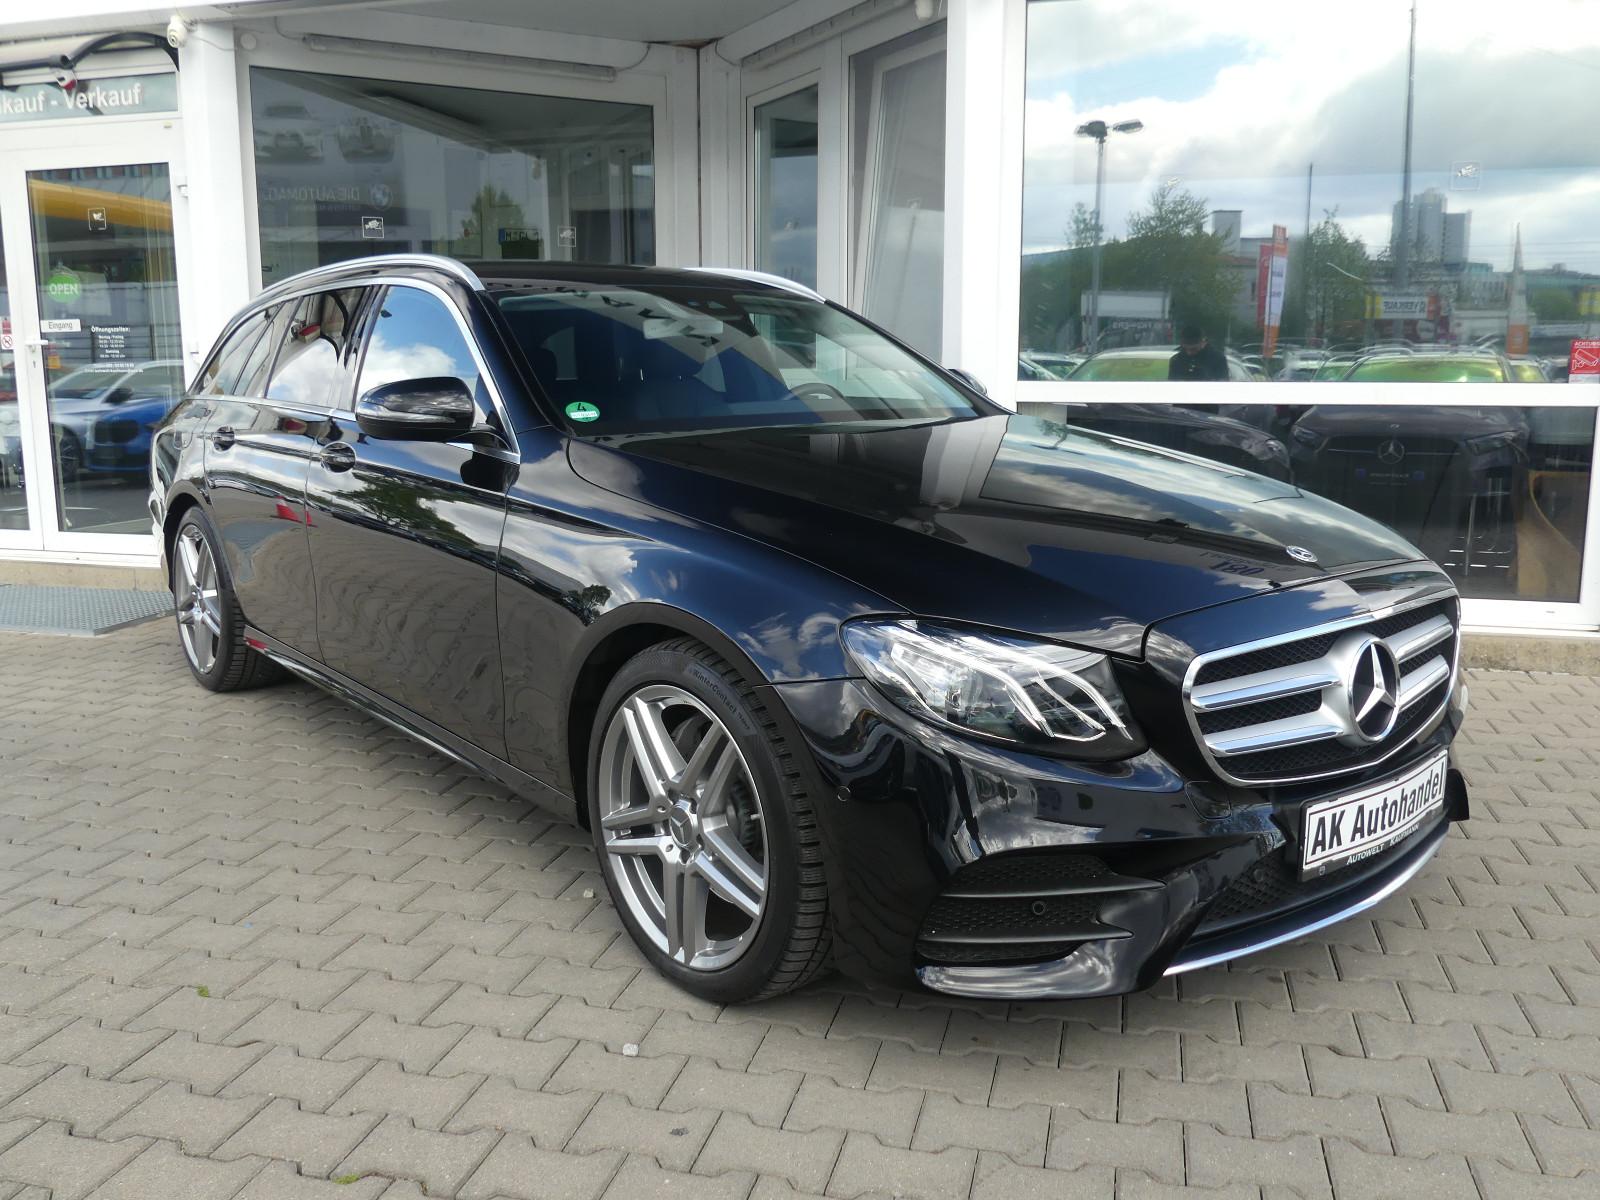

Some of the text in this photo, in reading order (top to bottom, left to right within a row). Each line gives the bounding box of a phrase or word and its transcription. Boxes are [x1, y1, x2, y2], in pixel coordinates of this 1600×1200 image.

[0, 90, 45, 115] kauf
[64, 83, 142, 109] Verkauf
[49, 283, 79, 295] OPEN
[48, 321, 73, 331] Eingang
[577, 402, 587, 411] 4
[1311, 762, 1444, 856] AK Autohandel
[1346, 844, 1385, 865] AUTOWELT
